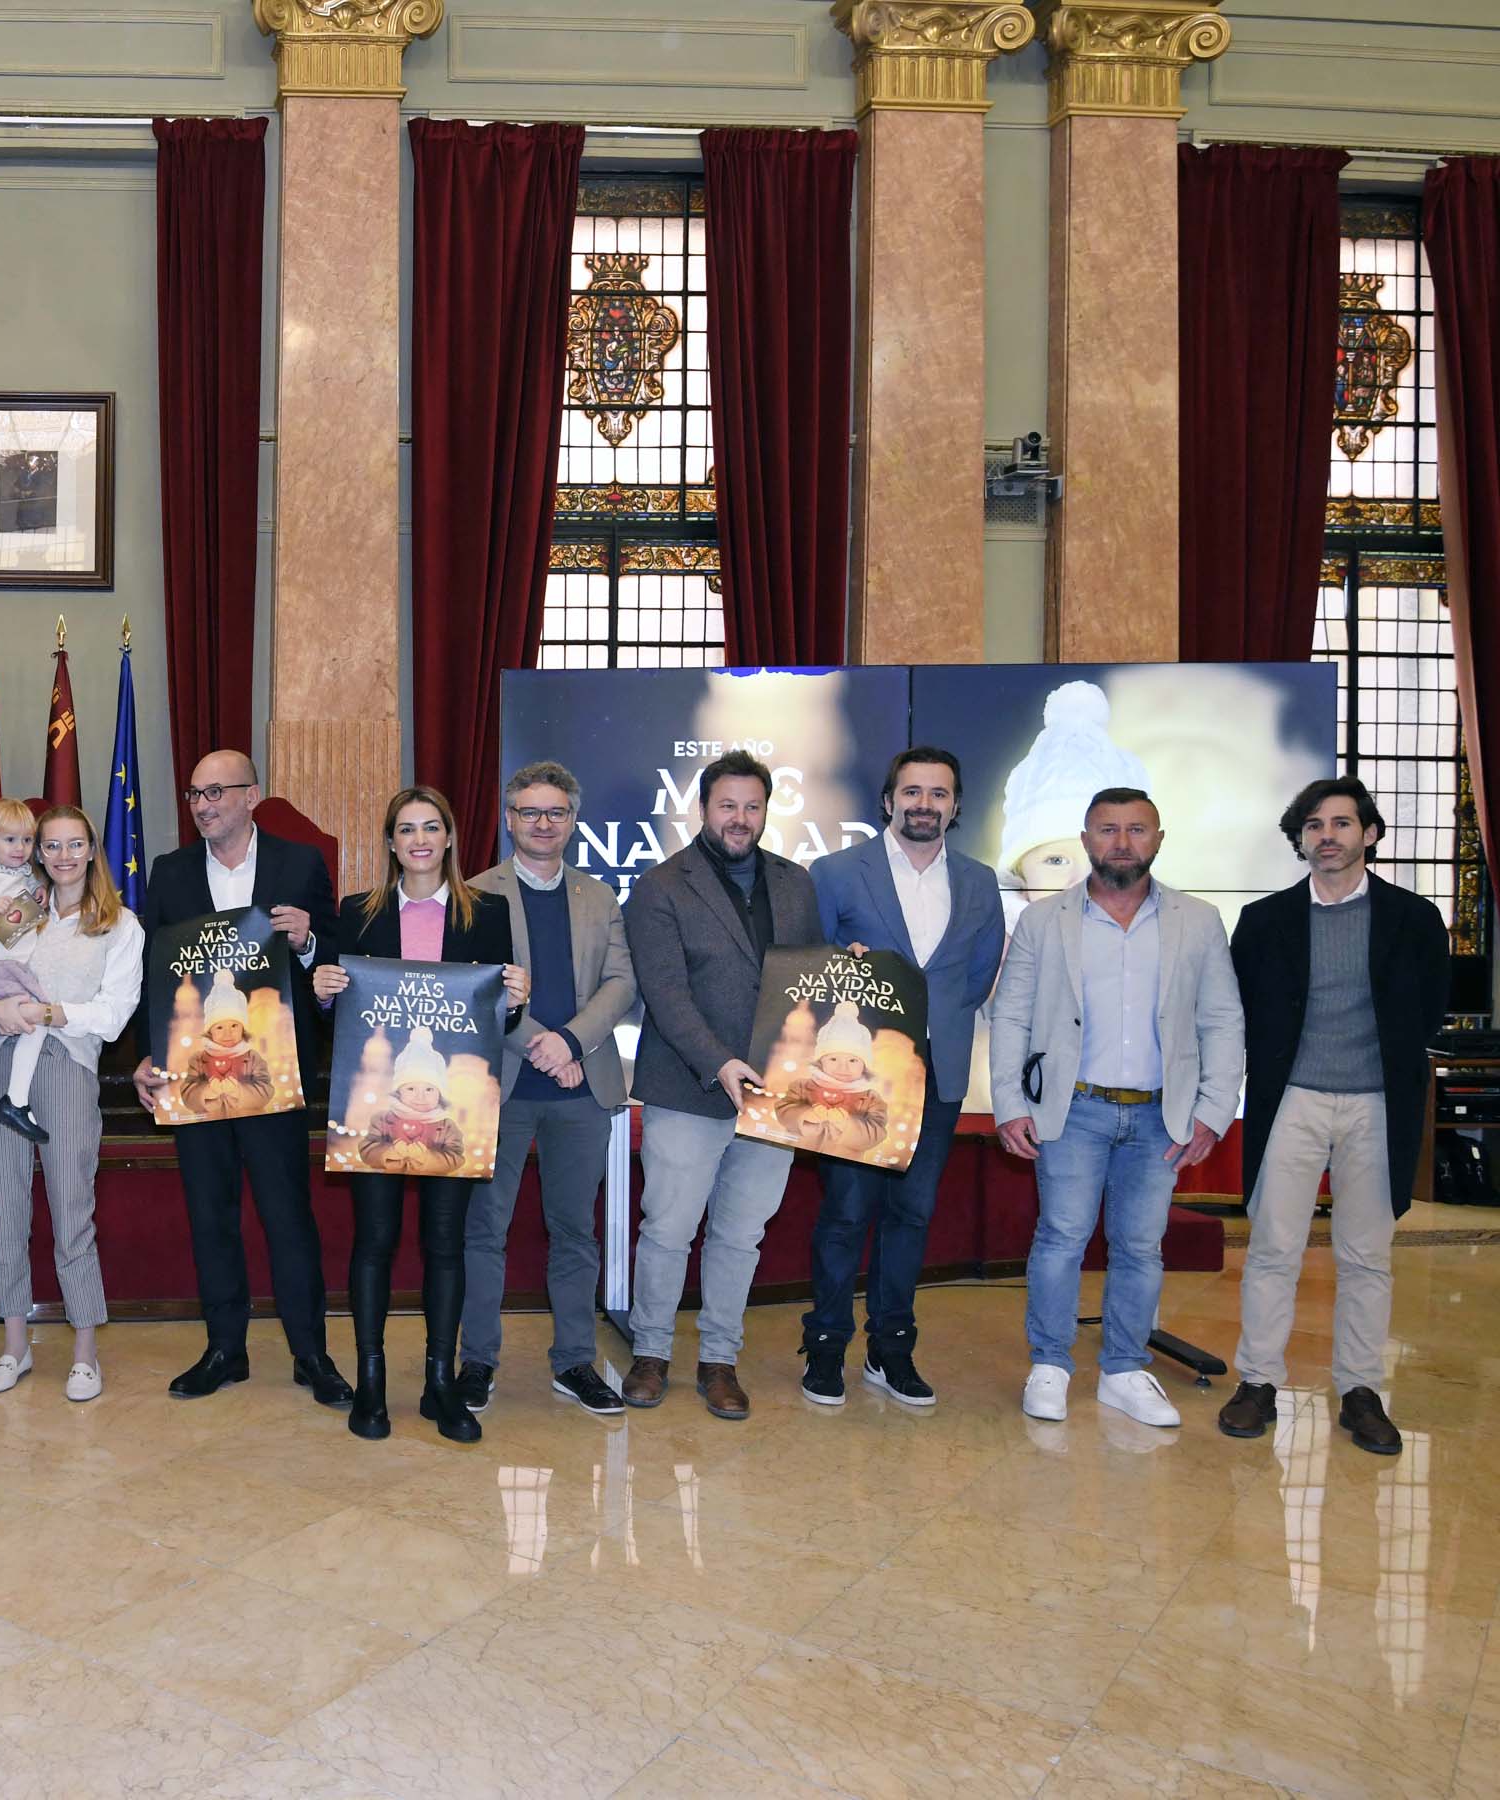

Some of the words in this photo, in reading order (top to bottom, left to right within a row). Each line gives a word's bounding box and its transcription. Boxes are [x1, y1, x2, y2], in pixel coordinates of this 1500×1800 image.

[674, 741, 723, 757] ESTE
[651, 766, 805, 816] MS
[198, 925, 239, 944] MÁS
[169, 960, 205, 977] QUE
[209, 955, 270, 973] NUNCA
[404, 971, 420, 979] ESTE
[398, 979, 445, 998] MÁS
[784, 986, 827, 1003] QUE
[832, 990, 905, 1015] NUNCA
[360, 1010, 402, 1028] QUE
[406, 1014, 479, 1034] NUNCA
